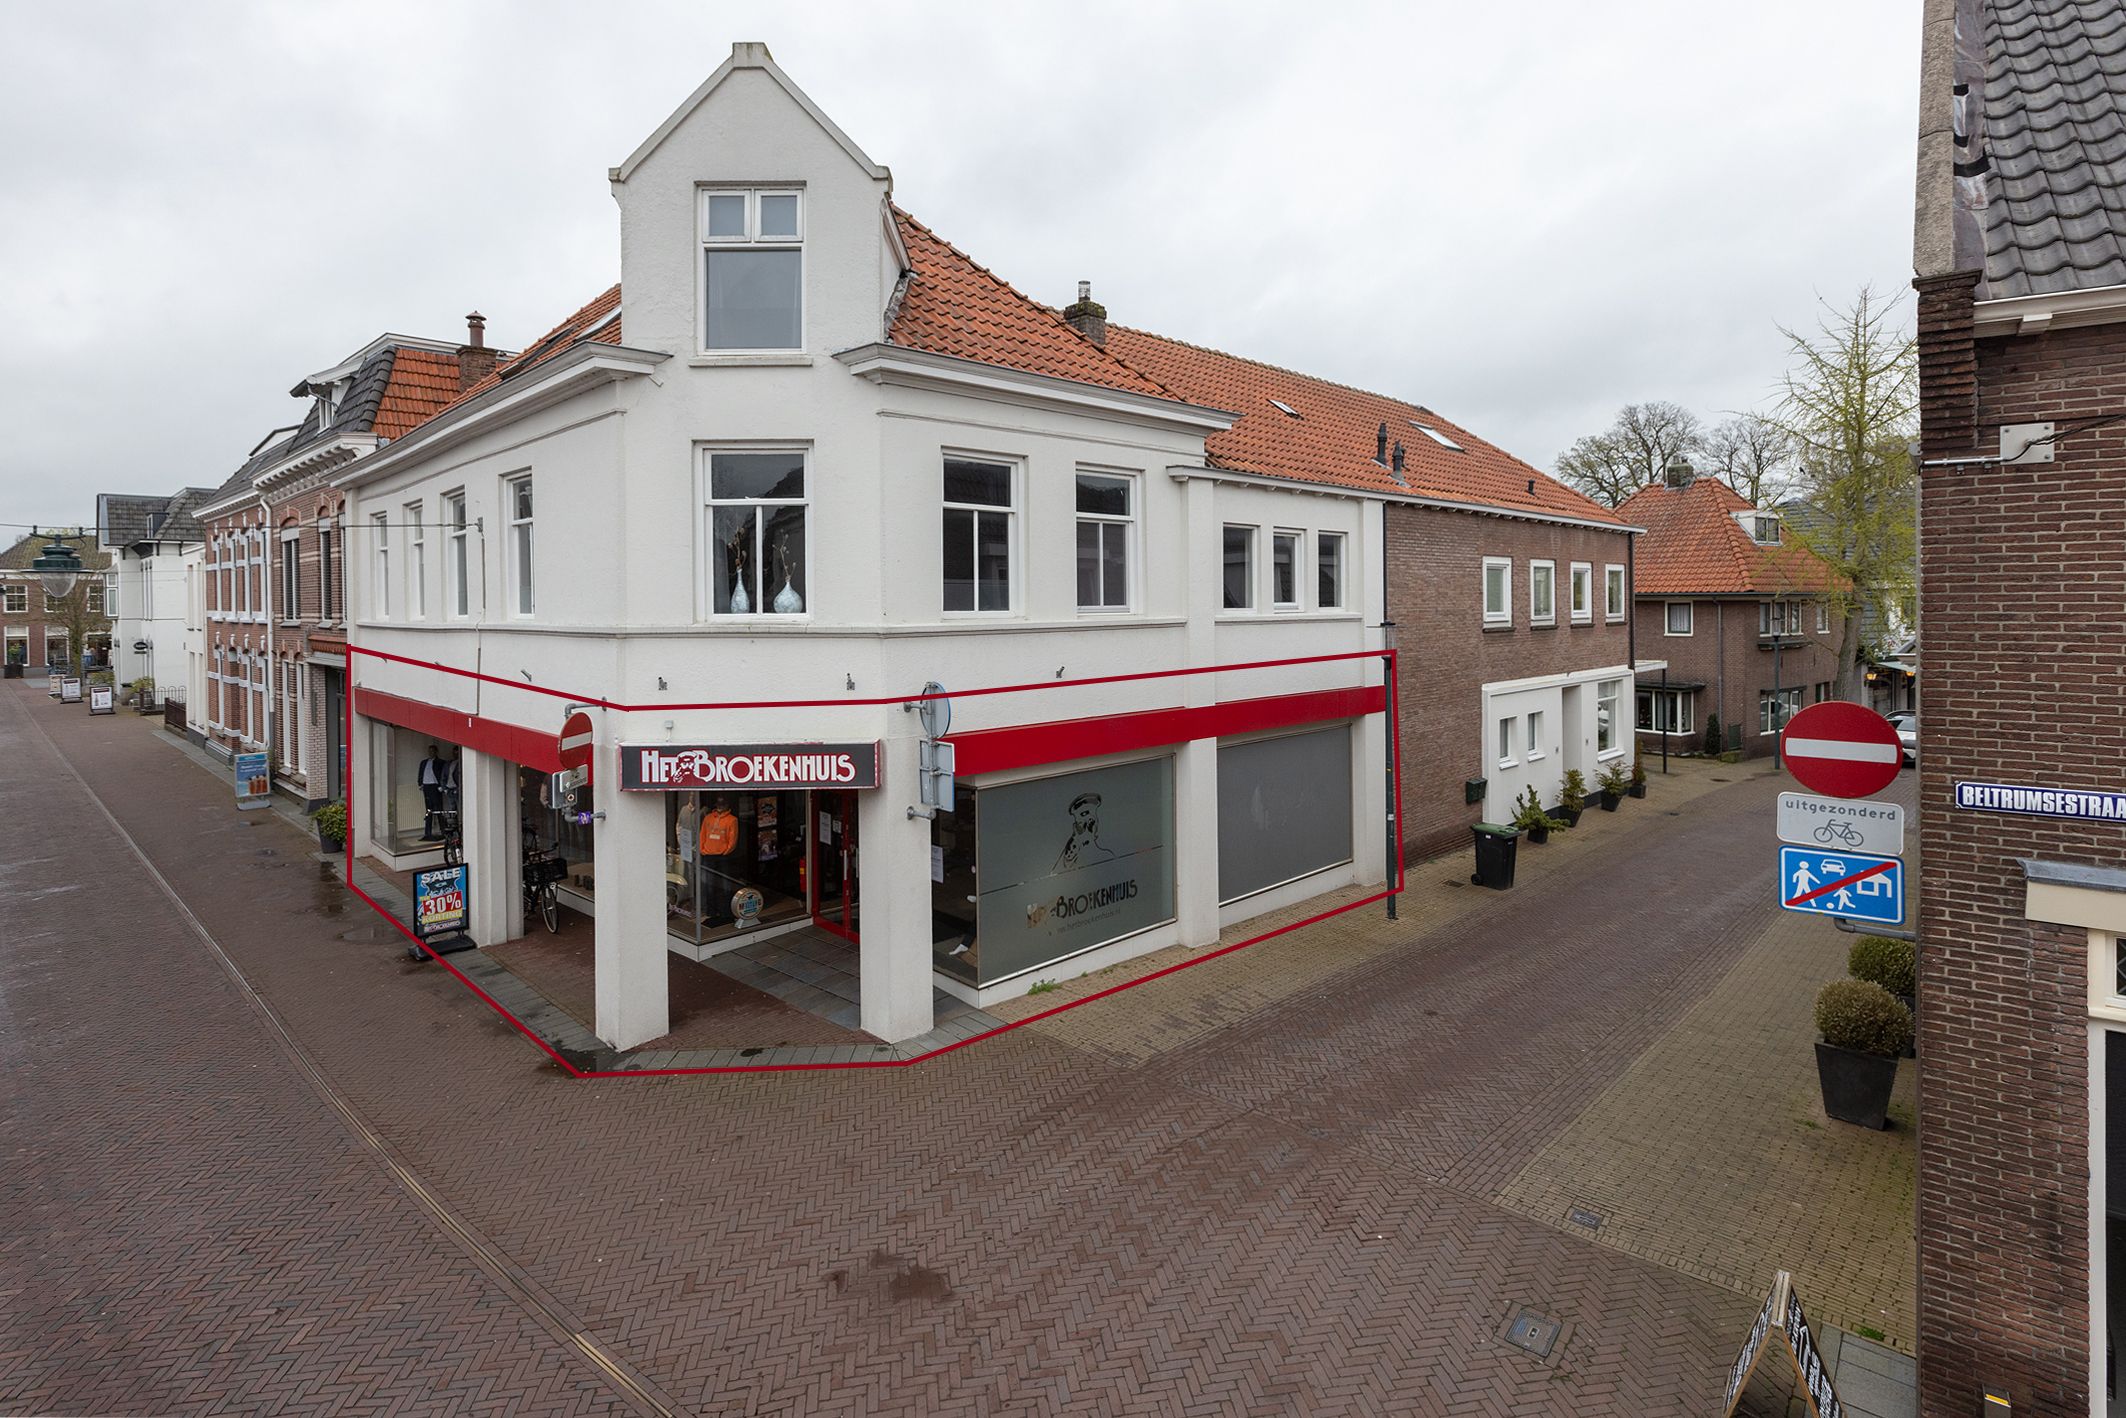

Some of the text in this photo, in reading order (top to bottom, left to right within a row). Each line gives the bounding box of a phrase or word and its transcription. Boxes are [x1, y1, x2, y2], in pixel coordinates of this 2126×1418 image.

[693, 750, 855, 784] BROEKENHUIS
[1785, 799, 1896, 821] uitgezonderd
[1962, 785, 2126, 819] BELTRUMSESTRAA
[421, 867, 460, 883] SALE
[425, 892, 462, 916] 30%
